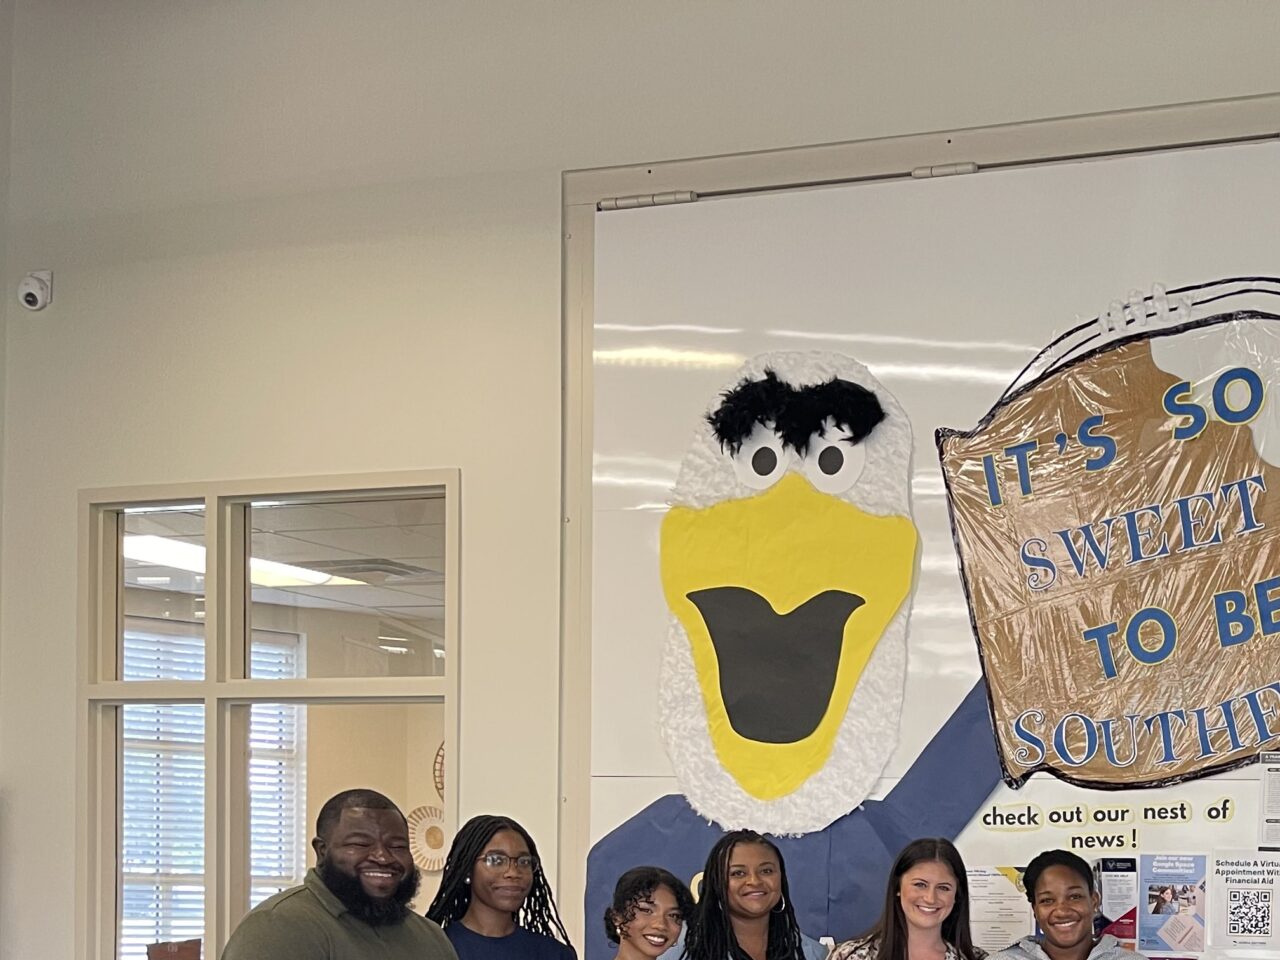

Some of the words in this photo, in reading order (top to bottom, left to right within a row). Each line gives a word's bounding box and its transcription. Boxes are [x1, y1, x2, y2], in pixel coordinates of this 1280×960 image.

[981, 414, 1118, 507] IT'S
[1162, 367, 1265, 441] SO
[1020, 475, 1267, 591] SWEET
[1083, 606, 1178, 680] TO
[982, 806, 1039, 826] check
[1048, 806, 1083, 823] out
[1093, 807, 1129, 821] our
[1143, 802, 1187, 820] nest
[1207, 798, 1230, 819] of
[1215, 859, 1251, 867] Schedule
[1215, 868, 1265, 876] Appointment
